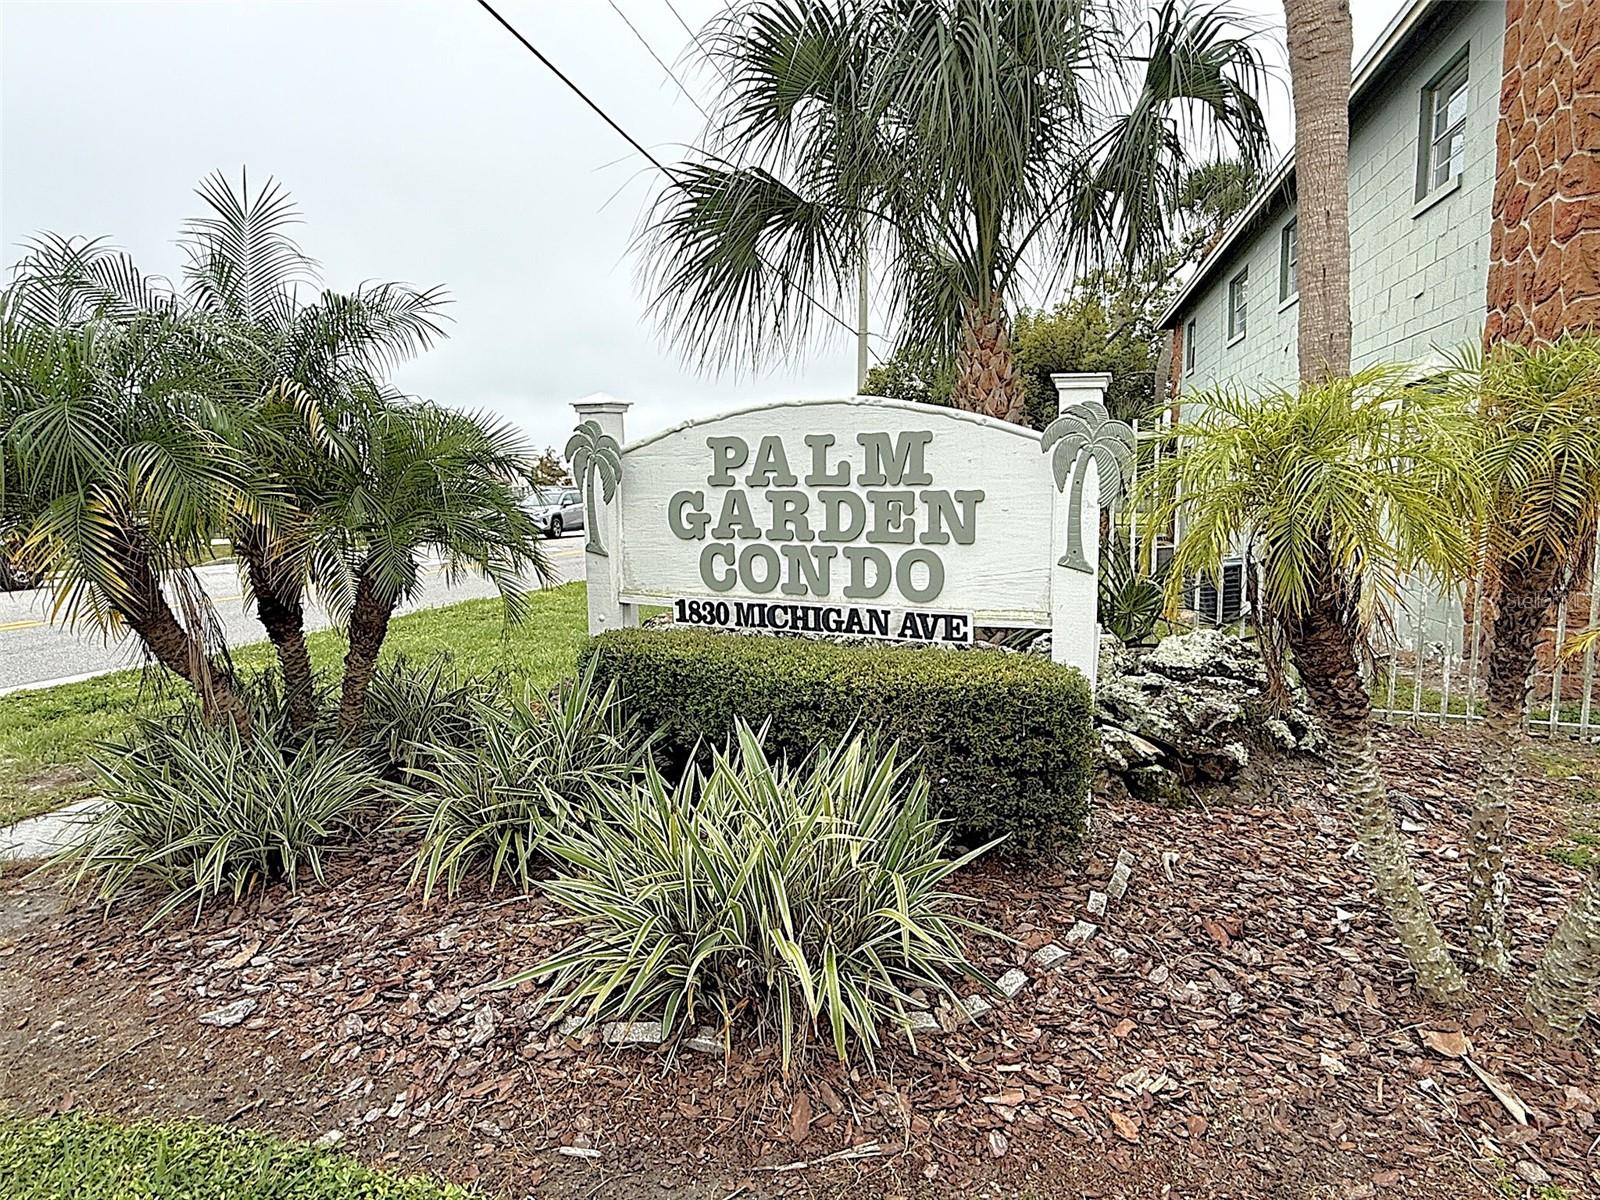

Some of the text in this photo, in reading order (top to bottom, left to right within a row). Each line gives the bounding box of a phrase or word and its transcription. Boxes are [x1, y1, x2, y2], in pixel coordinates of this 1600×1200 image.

[706, 430, 933, 487] PALM
[668, 489, 985, 545] GARDEN
[699, 542, 945, 602] CONDO
[674, 599, 969, 642] 1830 MICHIGAN AVE
